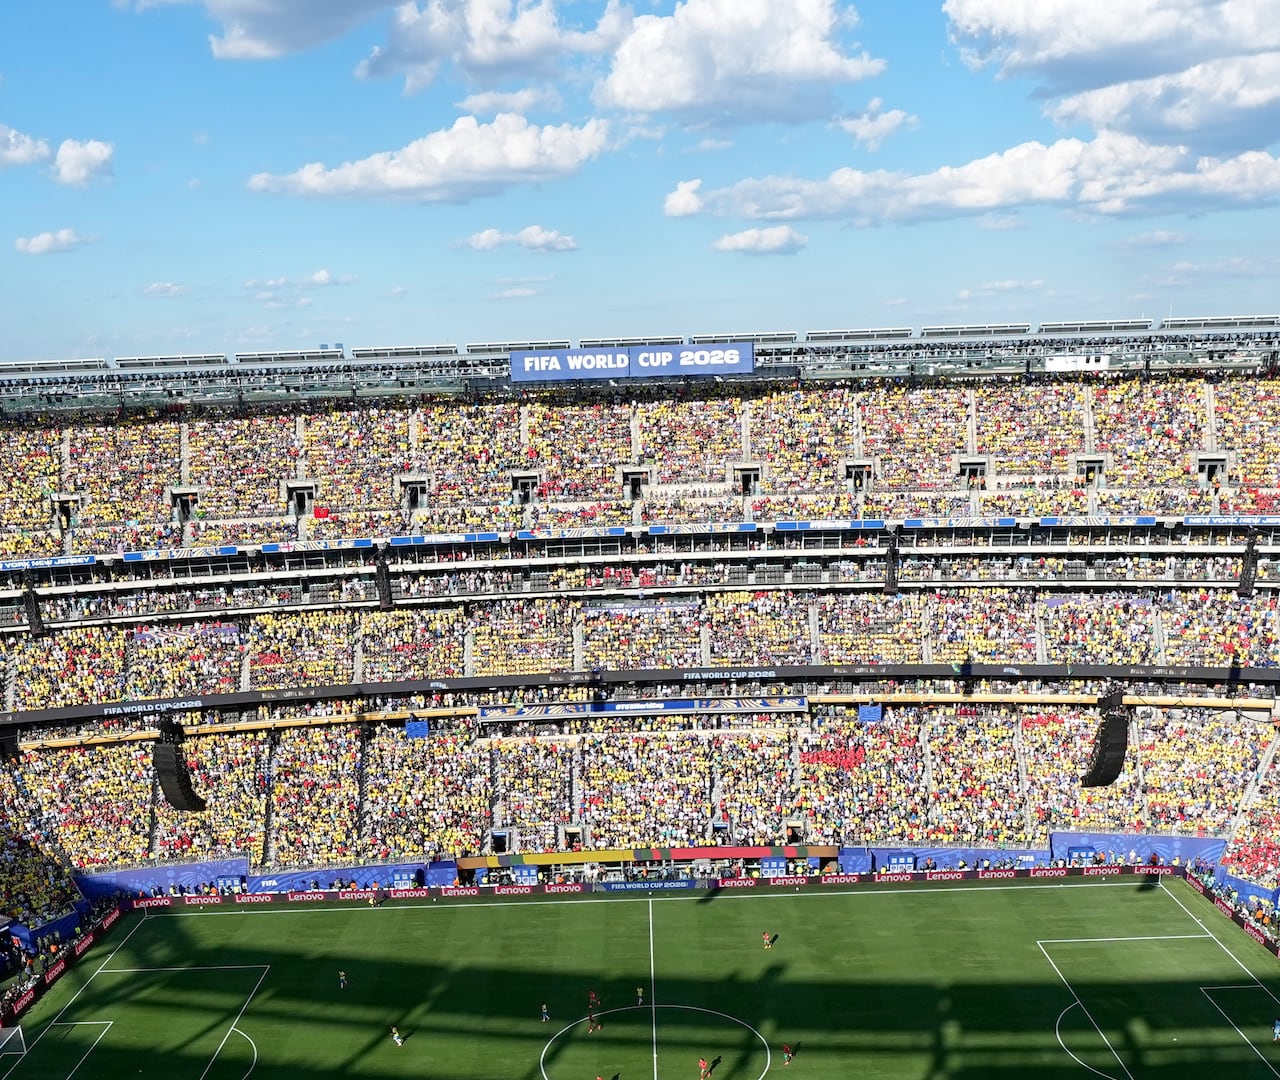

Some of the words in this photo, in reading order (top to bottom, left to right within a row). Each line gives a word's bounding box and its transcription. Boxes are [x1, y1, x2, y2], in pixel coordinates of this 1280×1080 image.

[524, 356, 561, 371] FIFA
[567, 353, 629, 370] WORLD
[638, 352, 673, 367] CUP
[680, 349, 740, 366] 2026
[1188, 516, 1209, 524] NEW
[1212, 516, 1235, 524] YORK
[1238, 516, 1260, 524] NEW
[4, 560, 28, 570] YORK
[28, 559, 50, 568] NEW
[51, 556, 90, 566] JERSEY
[683, 672, 702, 680] FIFA
[703, 671, 731, 680] WORLD
[731, 671, 747, 679] CUP
[747, 670, 776, 679] 2026
[104, 706, 122, 716] FIFA
[123, 704, 154, 715] WORLD
[155, 702, 171, 712] CUP
[172, 699, 203, 710] 2026
[979, 869, 1015, 879] Lenovo
[1030, 868, 1067, 877] Lenovo
[1083, 867, 1120, 876] Lenovo
[1134, 866, 1172, 875] Lenovo
[770, 876, 807, 886] Lenovo
[821, 874, 858, 884] Lenovo
[874, 873, 911, 883] Lenovo
[927, 871, 963, 881] Lenovo
[262, 879, 278, 887] FIFA
[649, 881, 663, 889] CUP
[663, 881, 688, 889] 2026
[719, 877, 755, 888] Lenovo
[391, 888, 427, 898] Lenovo
[442, 886, 477, 897] Lenovo
[494, 885, 531, 895] Lenovo
[545, 883, 581, 893] Lenovo
[236, 894, 271, 904] Lenovo
[288, 892, 324, 902] Lenovo
[339, 890, 376, 900] Lenovo
[133, 897, 170, 909] Lenovo
[185, 896, 220, 906] Lenovo
[1215, 897, 1233, 918] Lenovo
[102, 909, 120, 931] Lenovo
[1245, 923, 1265, 944] Lenovo
[74, 934, 94, 956] Lenovo
[44, 960, 66, 985] Lenovo
[13, 989, 36, 1014] Lenovo
